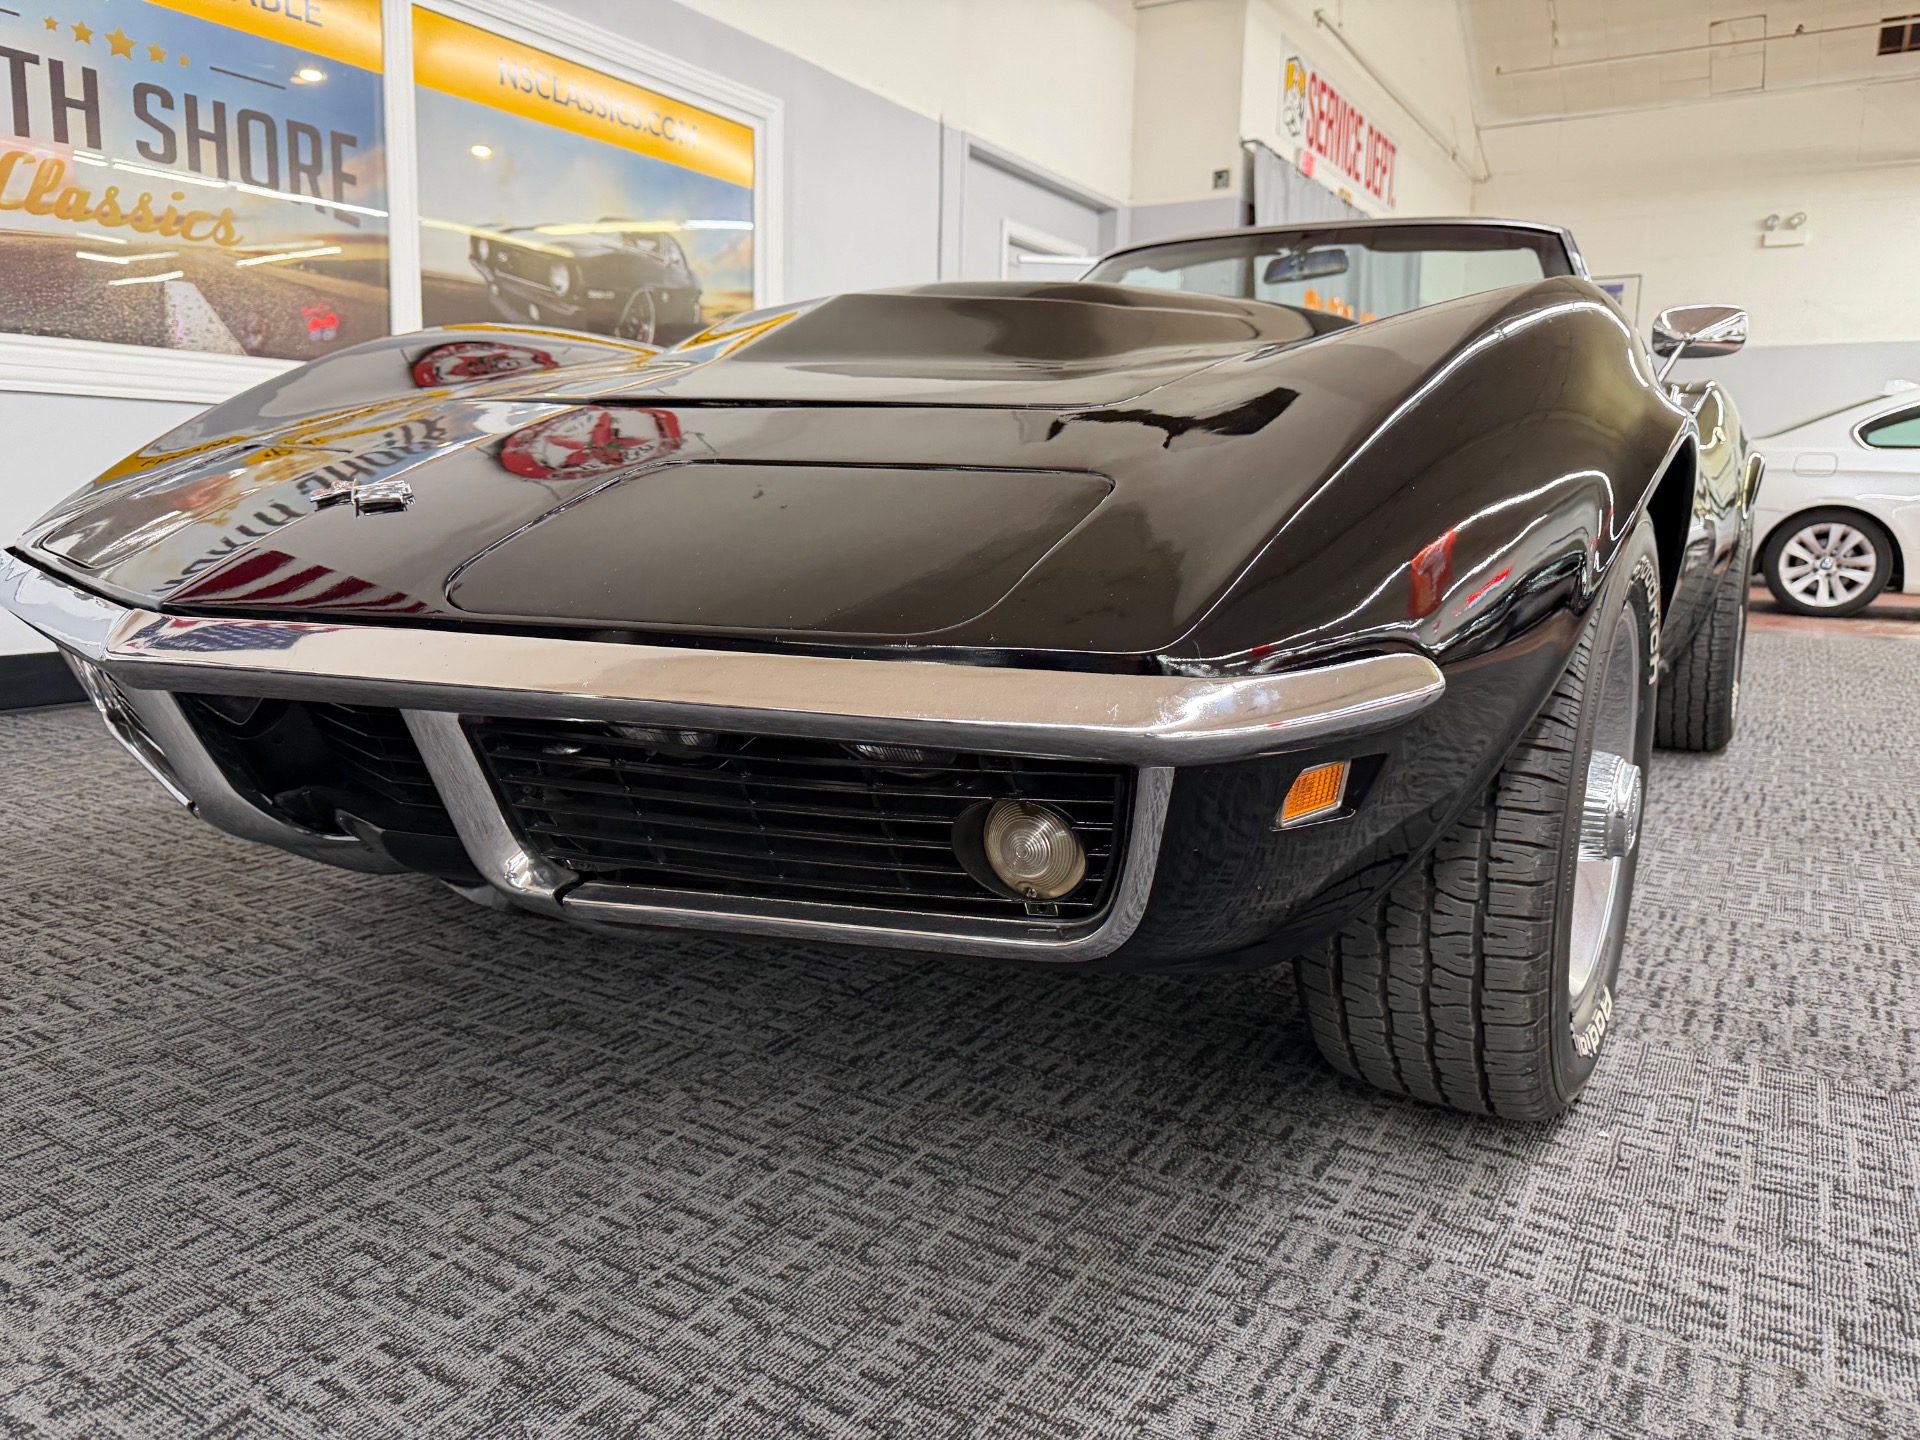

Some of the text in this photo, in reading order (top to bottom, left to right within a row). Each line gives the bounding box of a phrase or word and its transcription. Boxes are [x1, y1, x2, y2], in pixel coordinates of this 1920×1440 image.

[499, 55, 699, 150] NSCLASSICS.COM
[1306, 72, 1363, 184] SERVICE
[0, 150, 244, 246] Classics
[132, 82, 361, 228] SHORE
